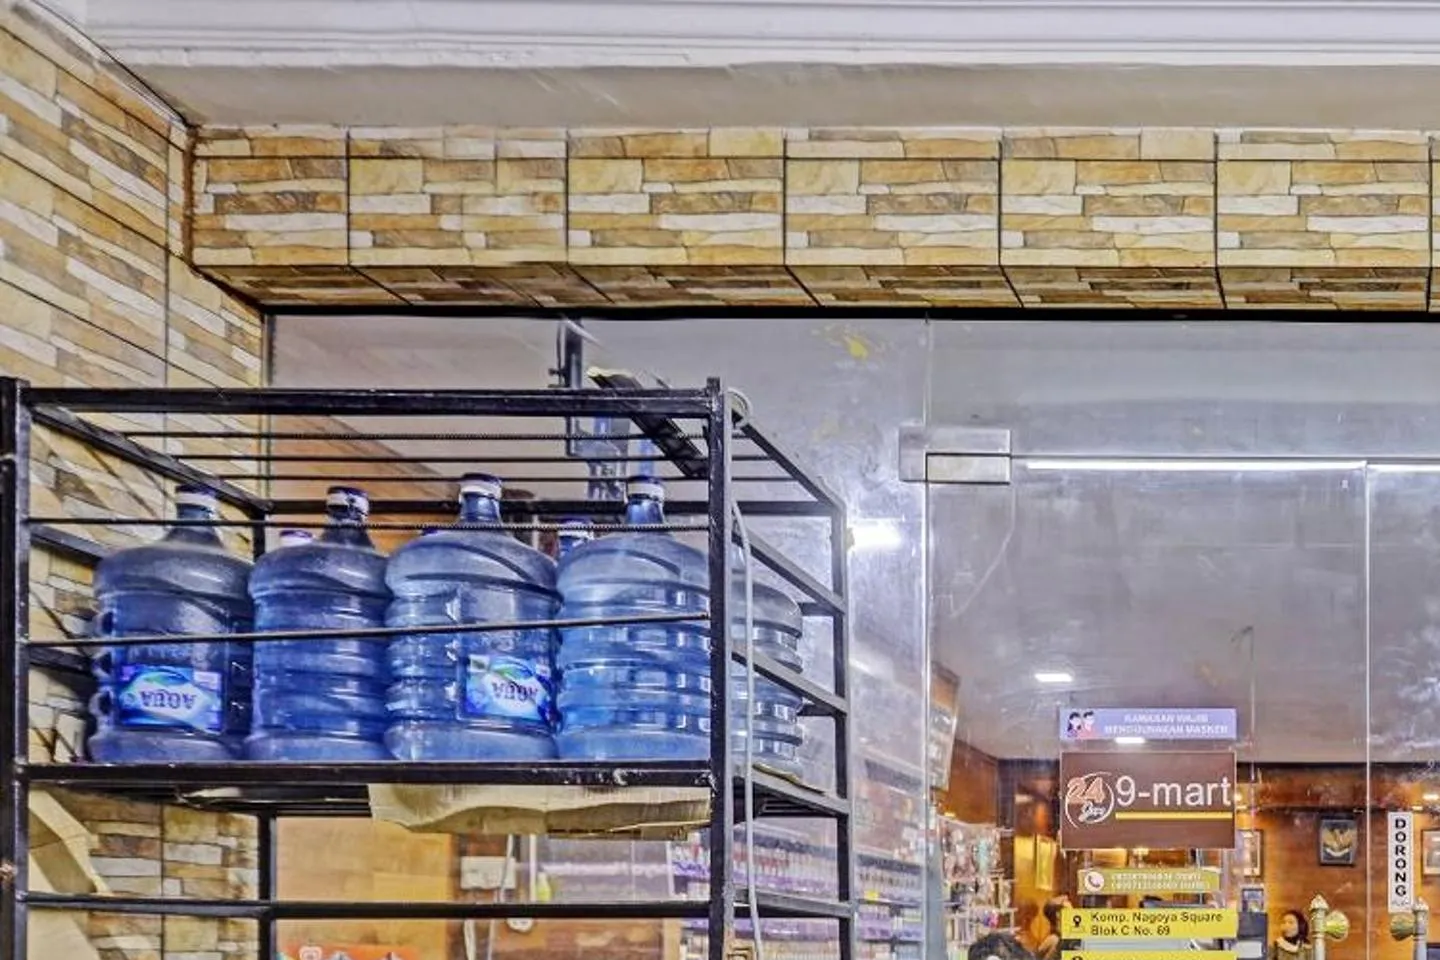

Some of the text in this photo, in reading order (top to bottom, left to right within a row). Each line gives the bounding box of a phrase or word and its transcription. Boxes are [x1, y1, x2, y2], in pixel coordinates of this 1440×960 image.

[140, 689, 198, 710] AQUA
[491, 680, 540, 702] AQUA
[1115, 775, 1231, 807] 9-mart
[1395, 818, 1407, 897] DORONG
[1091, 912, 1223, 924] Komp. Nagoya Square
[1091, 925, 1120, 936] Blok
[1121, 925, 1130, 936] C
[1134, 925, 1152, 936] No.
